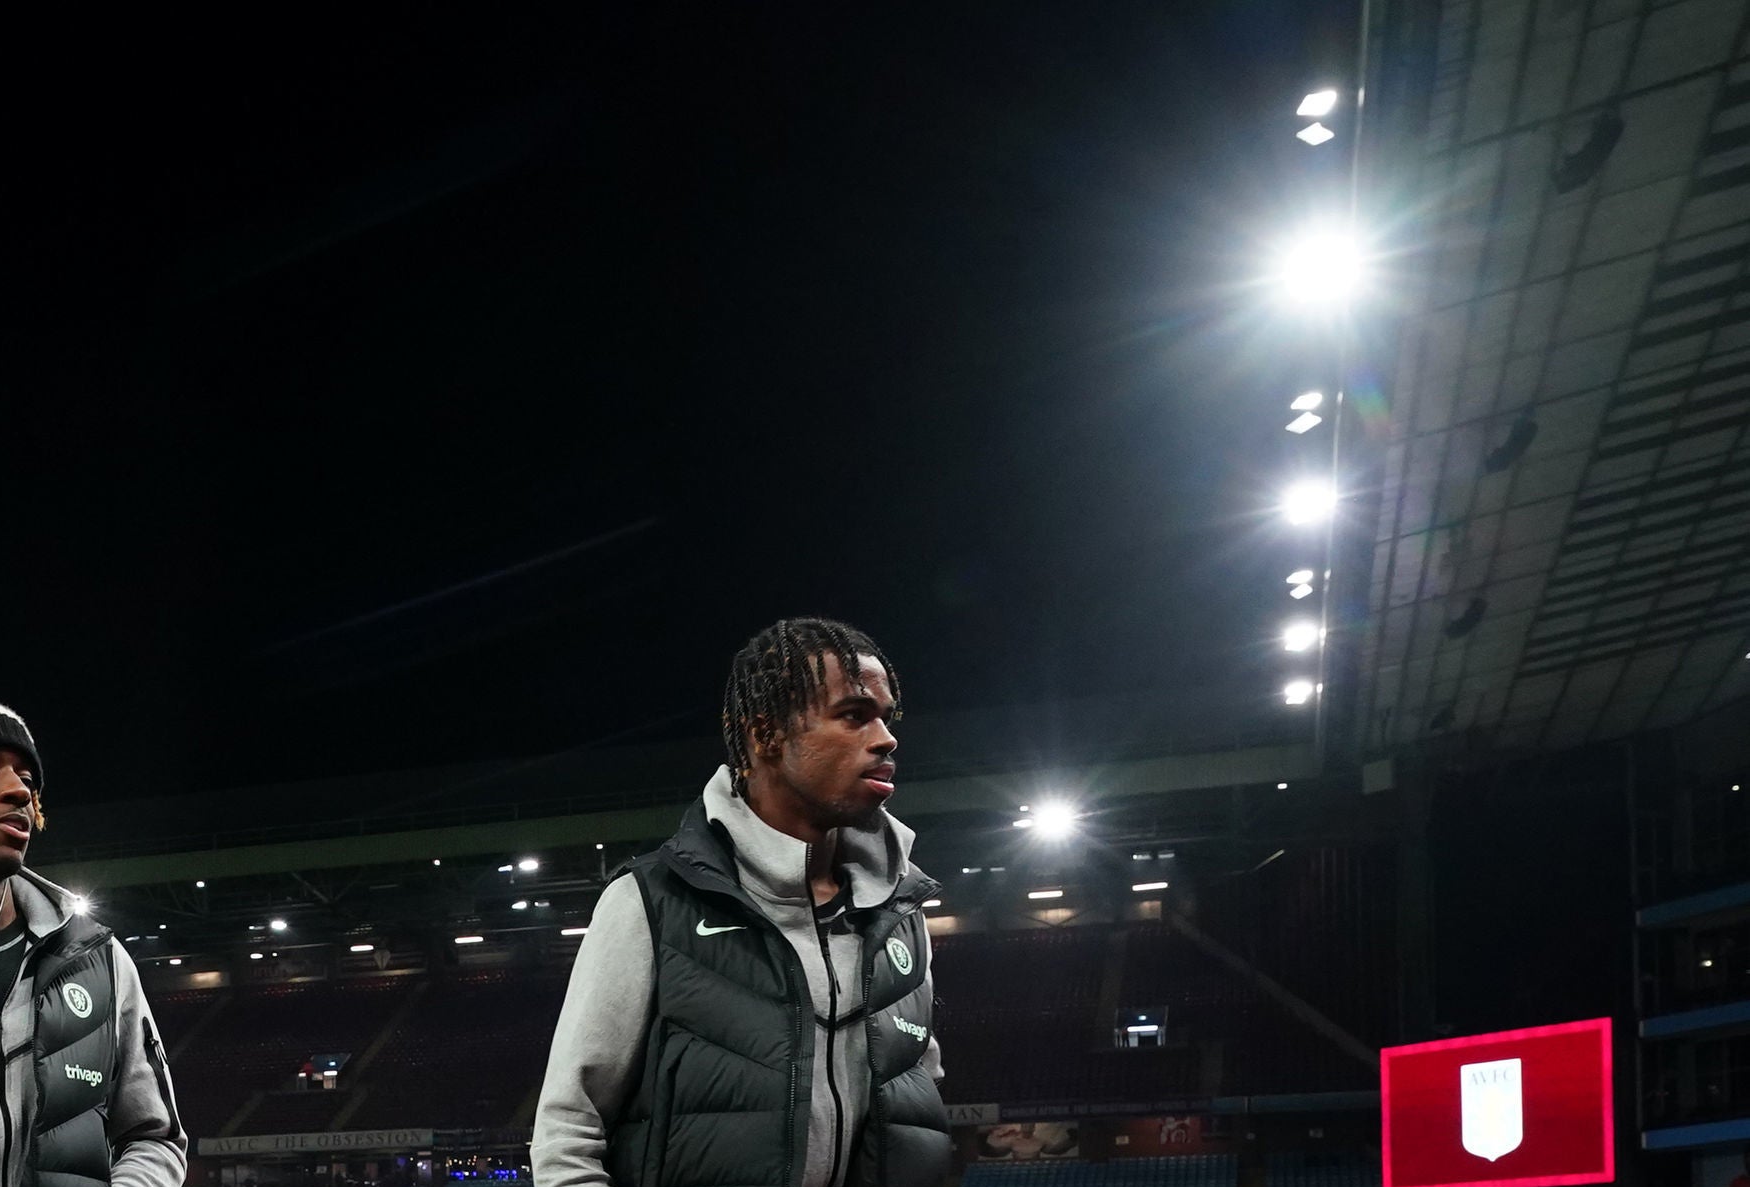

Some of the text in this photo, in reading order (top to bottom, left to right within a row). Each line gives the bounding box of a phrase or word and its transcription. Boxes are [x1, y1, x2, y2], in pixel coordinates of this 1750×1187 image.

[64, 1063, 103, 1087] trivago
[1468, 1066, 1517, 1086] AVFC
[273, 1133, 308, 1150] THE
[316, 1131, 422, 1148] OBSESSION
